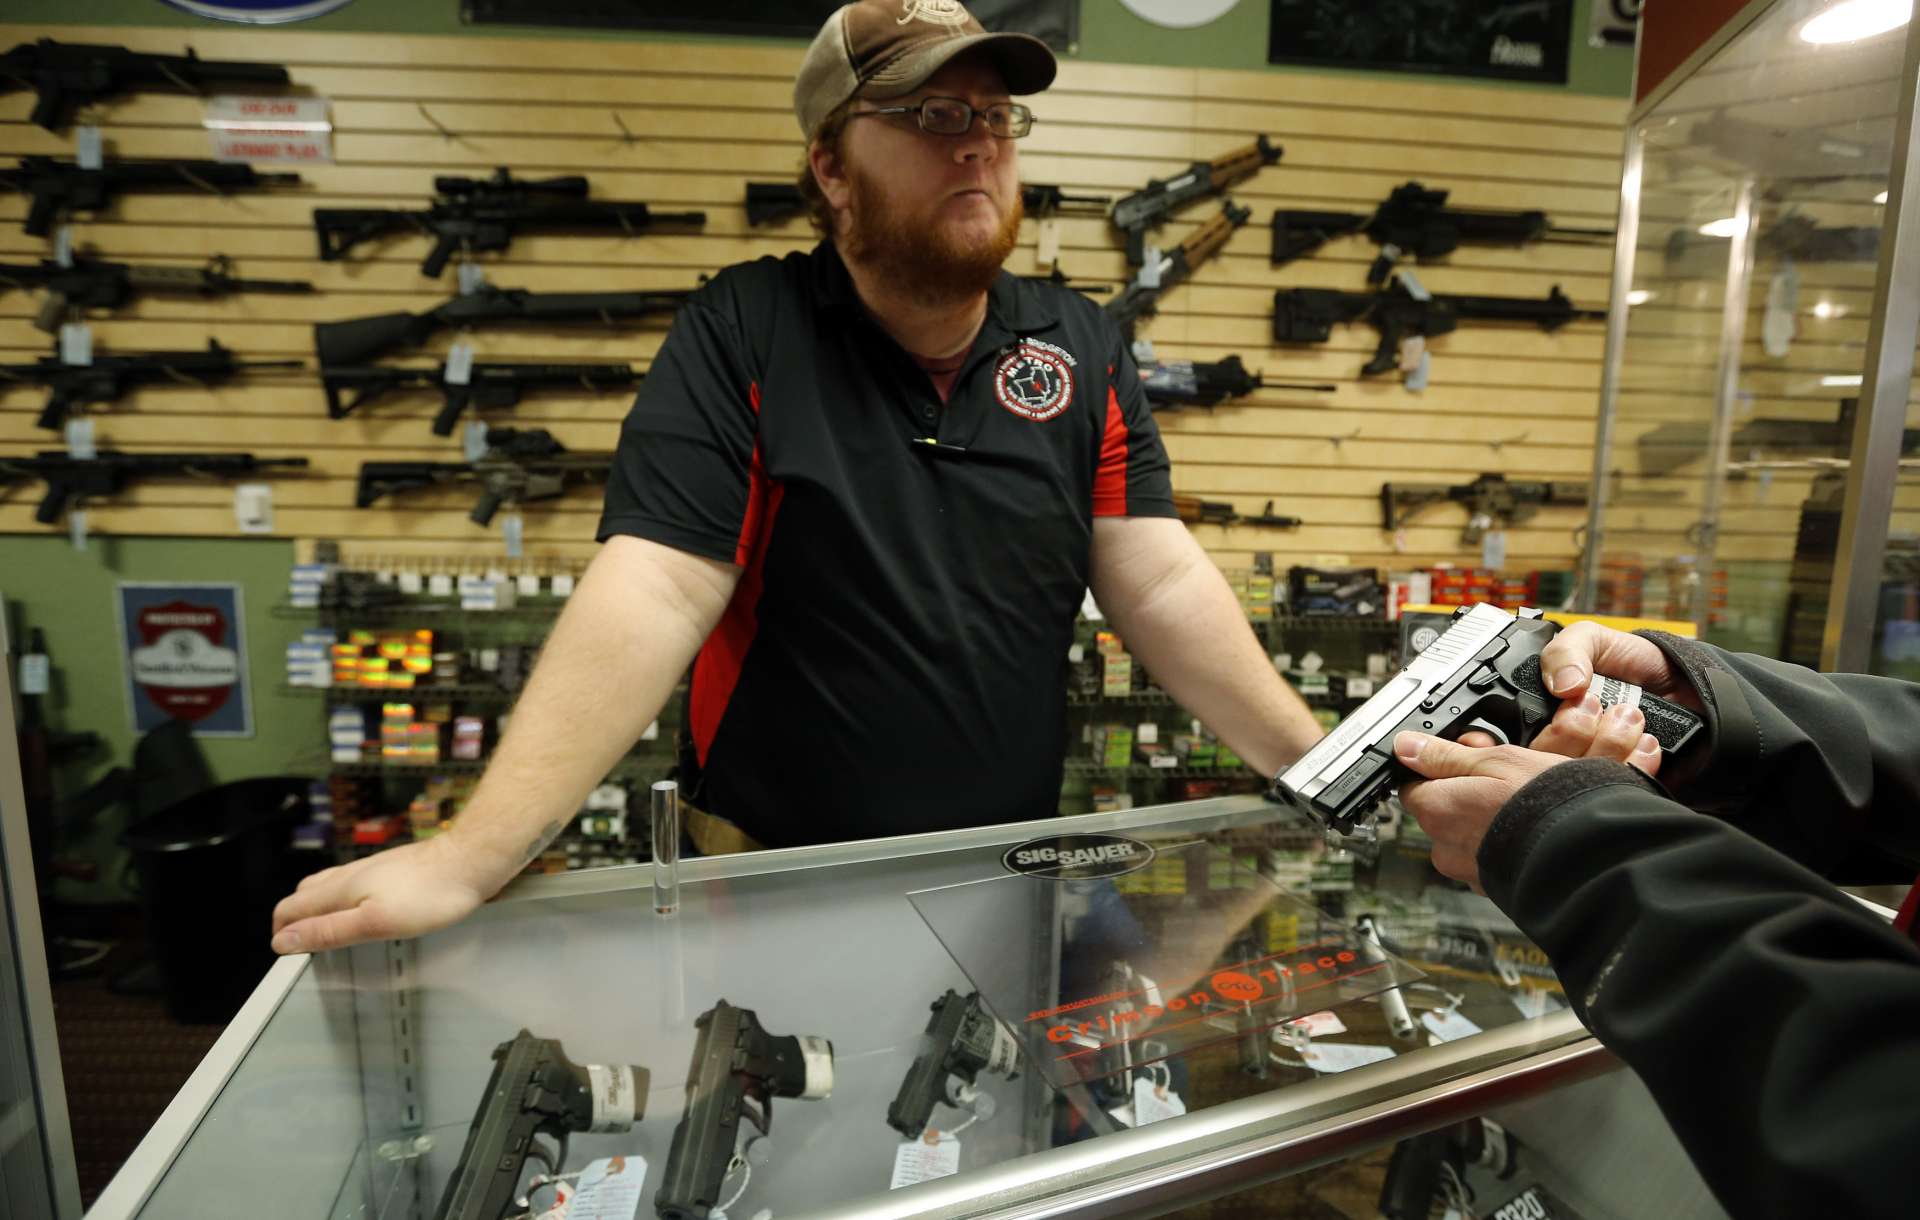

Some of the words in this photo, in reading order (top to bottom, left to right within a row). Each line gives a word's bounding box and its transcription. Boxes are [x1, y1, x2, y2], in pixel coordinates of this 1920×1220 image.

[1006, 356, 1054, 379] METRO
[1047, 991, 1211, 1042] Crimson
[1258, 951, 1356, 986] Trace
